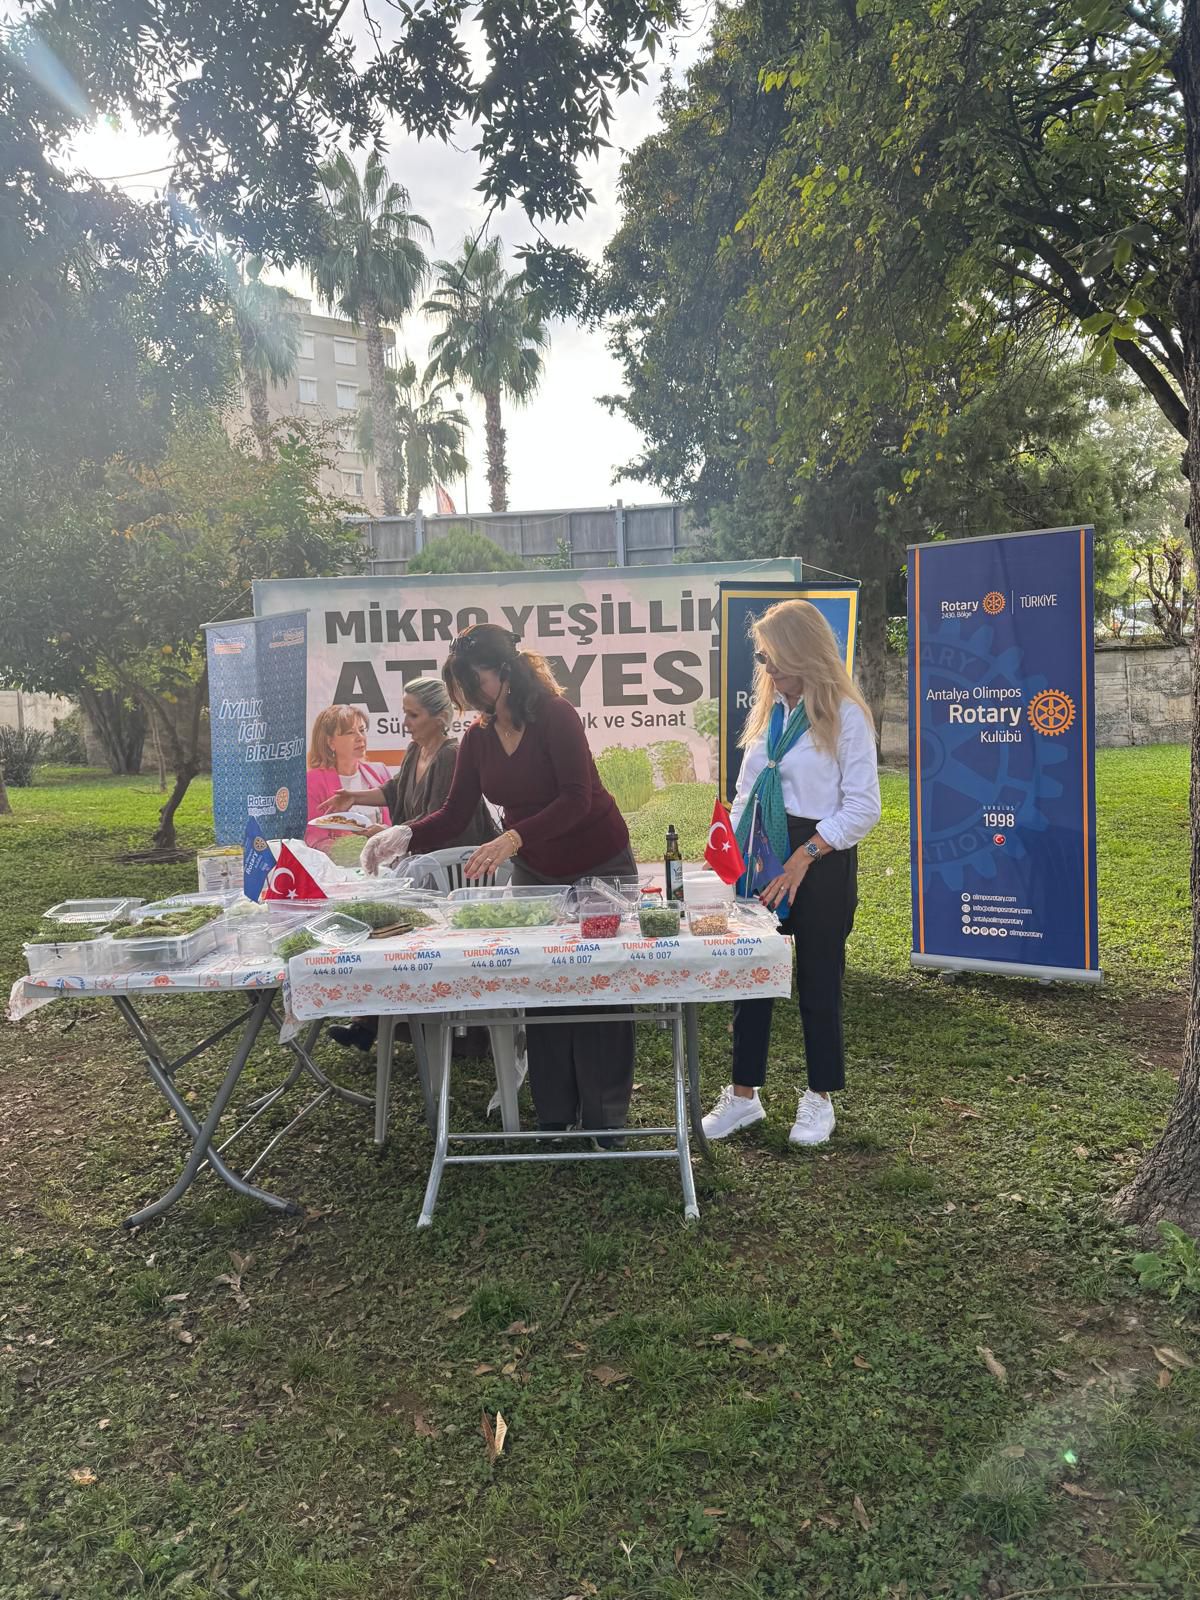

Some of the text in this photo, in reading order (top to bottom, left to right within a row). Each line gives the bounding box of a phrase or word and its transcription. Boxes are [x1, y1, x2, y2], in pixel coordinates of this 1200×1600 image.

[941, 600, 979, 612] Rotary
[1020, 594, 1057, 608] TÜRKİYE
[957, 611, 972, 619] Bölge
[926, 686, 1022, 702] Antalya Olimpos
[219, 697, 263, 719] İYİLİK
[604, 715, 625, 728] ve
[631, 711, 686, 728] Sanat
[949, 704, 1022, 726] Rotary
[239, 719, 267, 742] İÇİN
[980, 730, 1022, 743] Kulübü
[246, 736, 304, 761] BİRLEŞİN
[247, 794, 275, 808] Rotary
[983, 813, 1015, 828] 1998
[543, 943, 601, 954] TURUNÇMASA
[622, 940, 680, 950] TURUNÇMASA
[384, 951, 441, 961] TURUNÇMASA
[463, 947, 520, 957] TURUNÇMASA
[630, 952, 646, 960] 444
[656, 951, 672, 959] 007
[712, 948, 727, 956] 444
[305, 954, 361, 966] TURUNÇMASA
[471, 960, 487, 968] 444
[496, 959, 512, 967] 007
[551, 956, 567, 965] 444
[577, 955, 592, 963] 007
[313, 968, 329, 976] 444
[338, 967, 354, 975] 007
[392, 964, 408, 972] 444
[417, 963, 433, 971] 007
